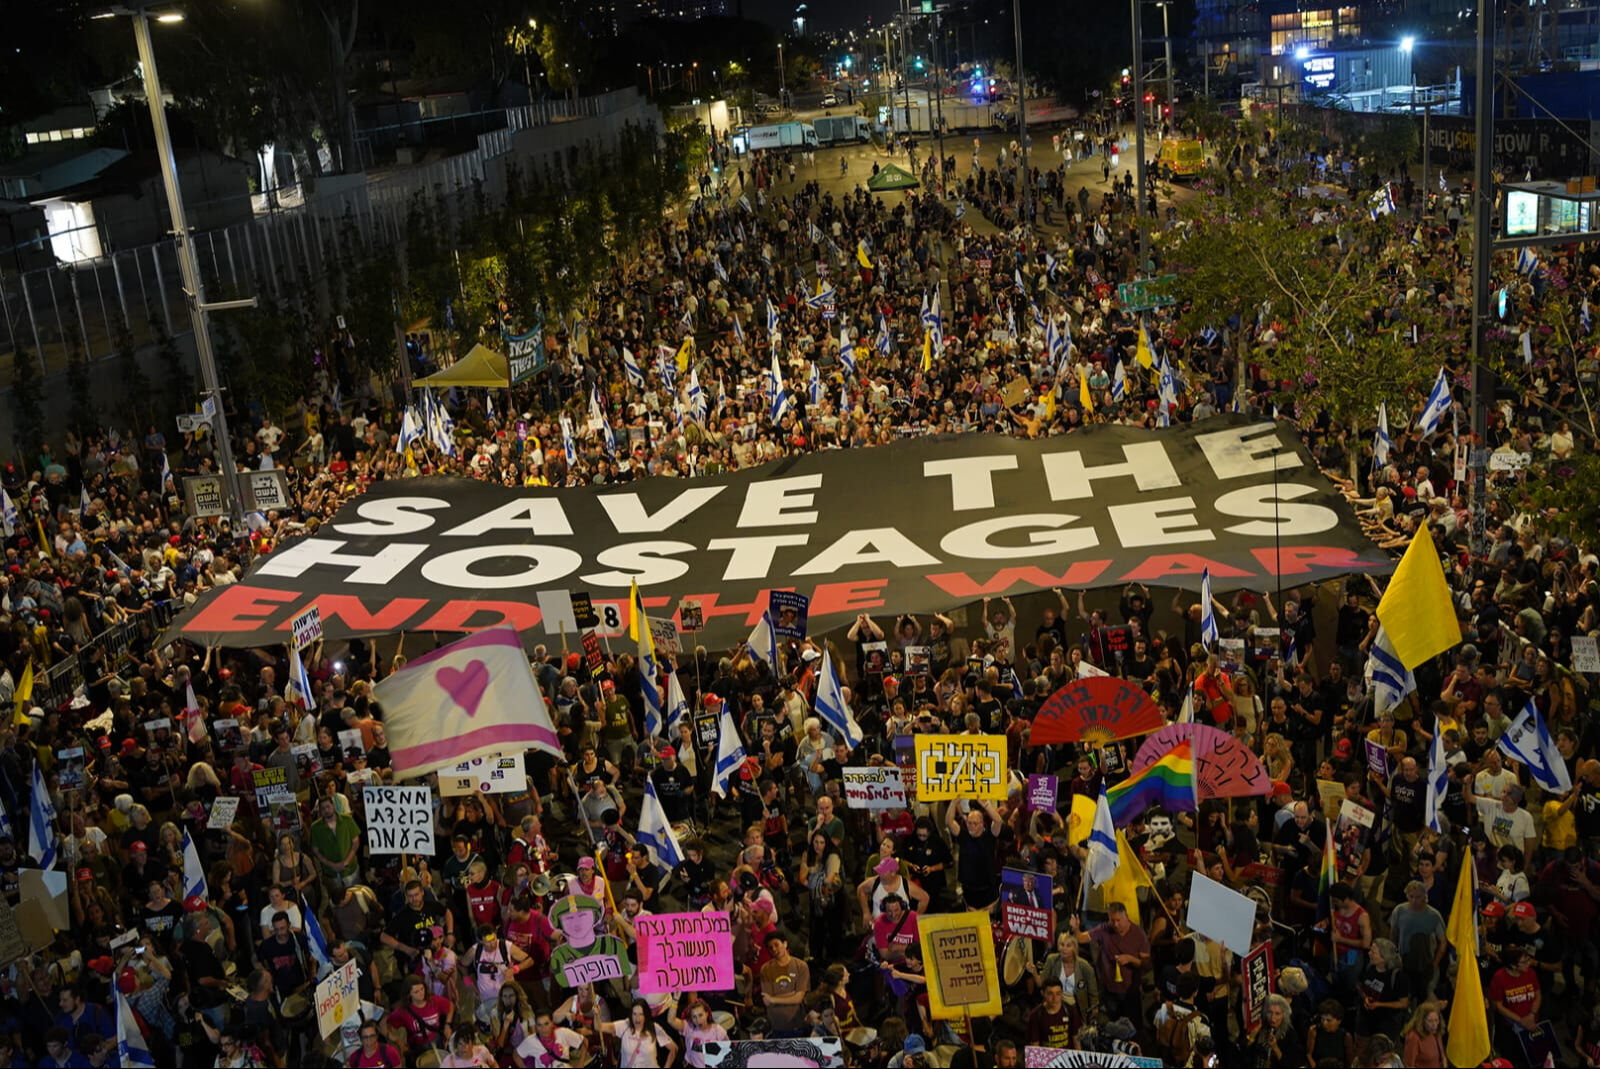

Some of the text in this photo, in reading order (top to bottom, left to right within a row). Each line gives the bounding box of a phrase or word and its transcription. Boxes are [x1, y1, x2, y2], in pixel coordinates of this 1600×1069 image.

[1497, 133, 1550, 152] TOWR
[334, 422, 1304, 536] SAVE THE
[255, 483, 1339, 589] HOSTAGES
[181, 584, 542, 633] END
[926, 545, 1386, 598] WAR
[926, 778, 991, 795] הביתה!
[365, 788, 426, 805] ממשלה
[371, 807, 429, 826] בוגדת
[368, 826, 430, 849] בעמה
[1007, 906, 1048, 919] END THIS
[638, 912, 730, 937] במלחמת נצח
[1008, 921, 1048, 938] WAR
[939, 933, 977, 947] מורשת
[656, 937, 716, 964] תעשה לך
[564, 957, 621, 983] הופקר
[656, 963, 717, 988] ממשלה
[961, 962, 983, 974] בתי
[949, 974, 984, 988] קברות
